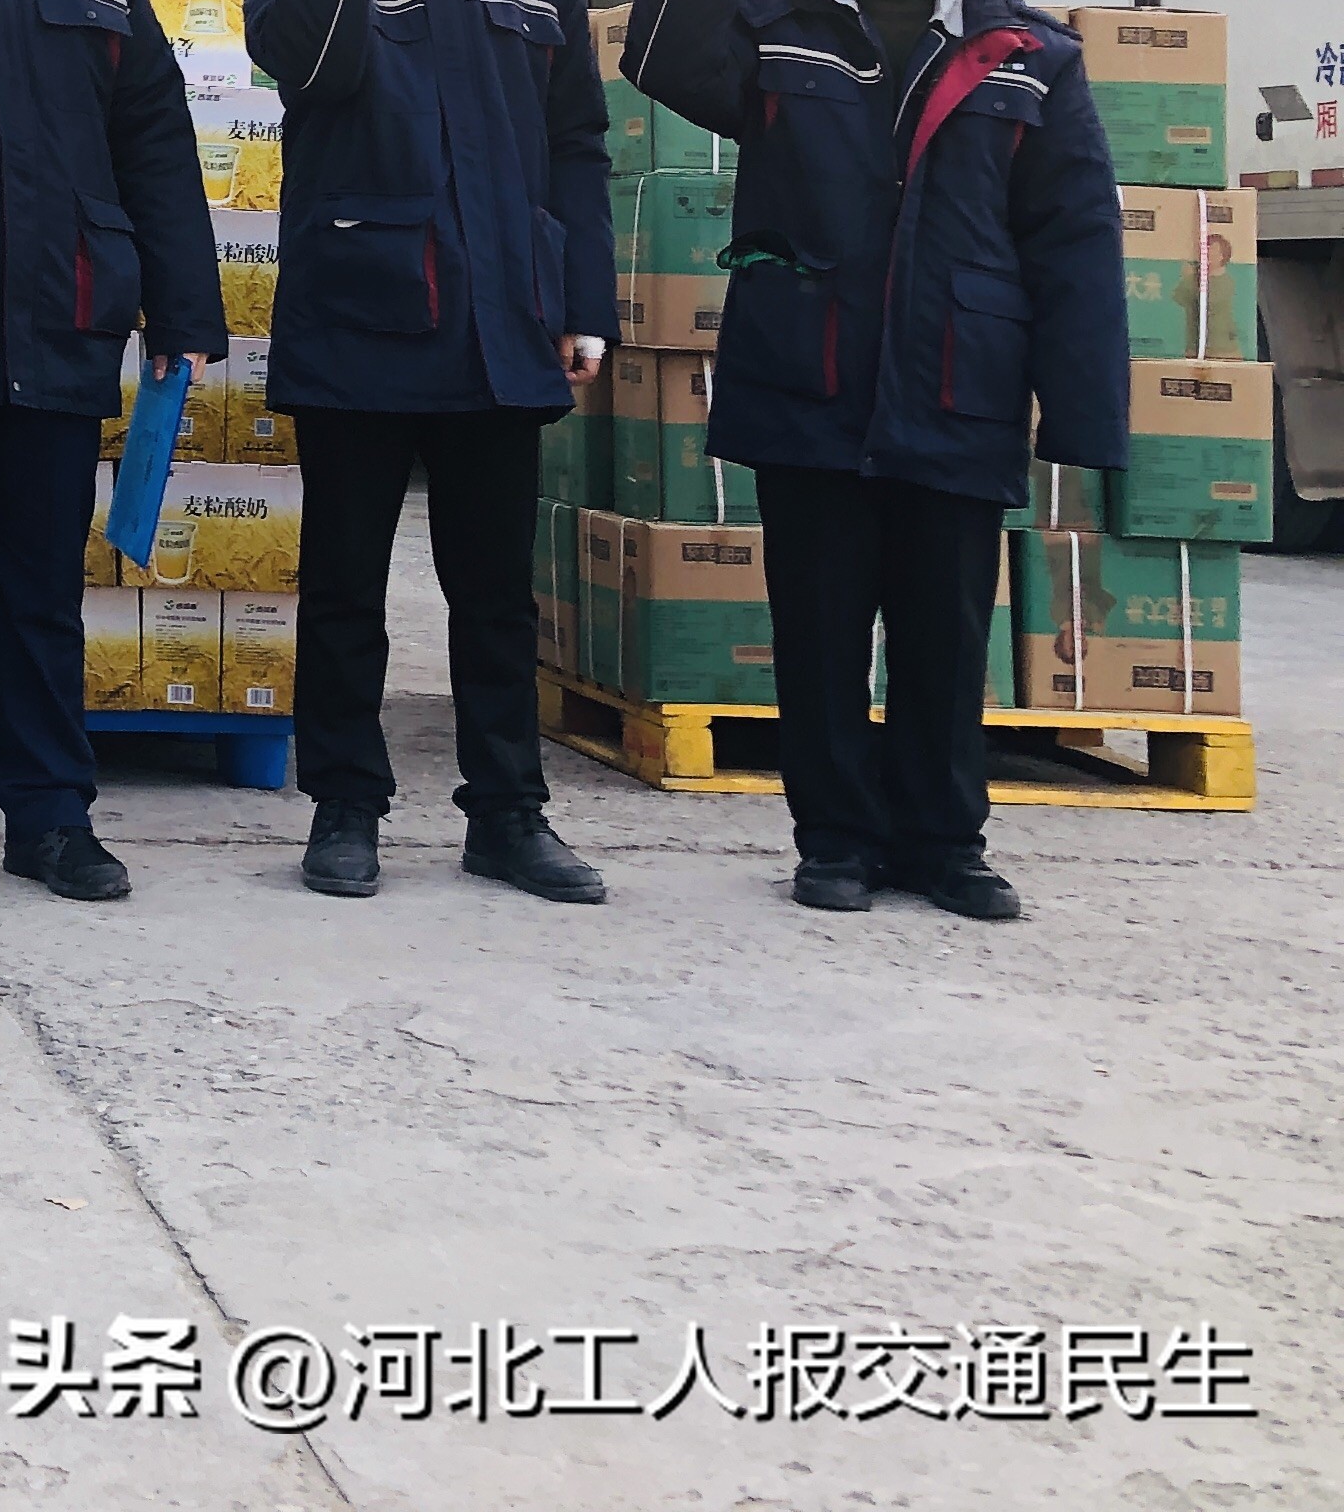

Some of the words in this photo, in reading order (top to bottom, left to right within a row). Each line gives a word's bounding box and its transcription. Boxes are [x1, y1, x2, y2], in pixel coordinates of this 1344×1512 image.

[1315, 41, 1344, 88] 冷
[182, 494, 268, 519] 麦粒酸奶
